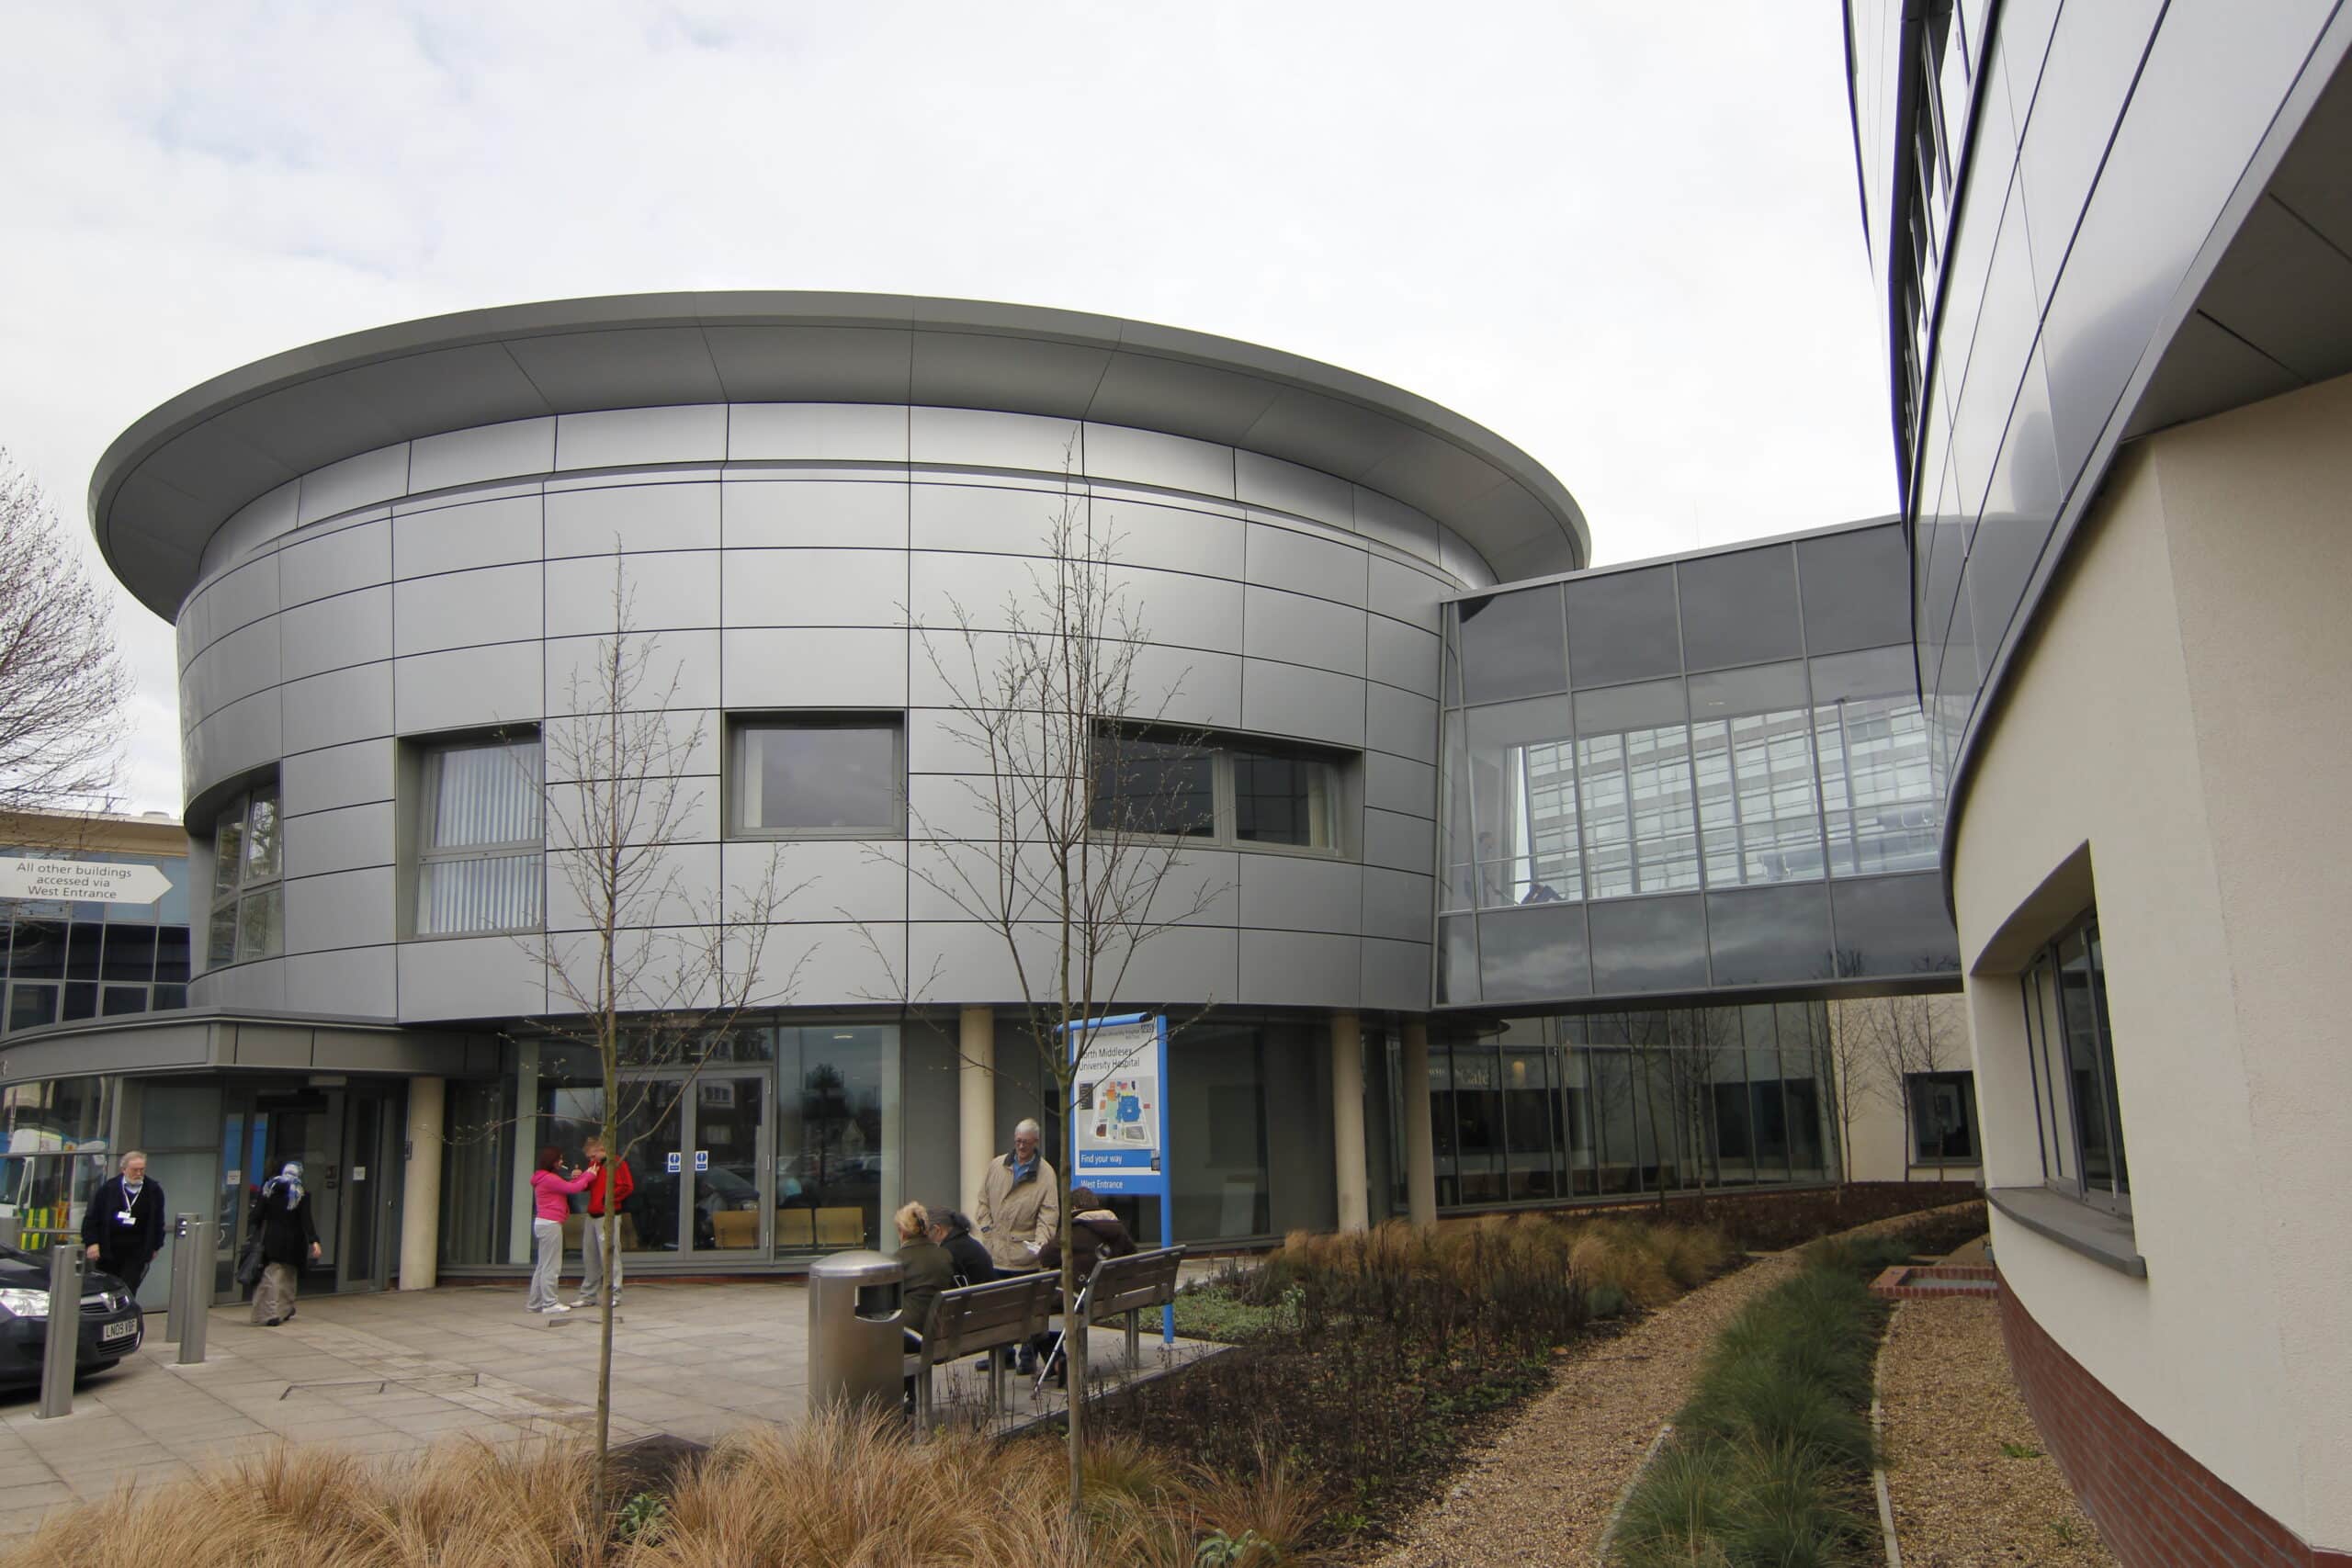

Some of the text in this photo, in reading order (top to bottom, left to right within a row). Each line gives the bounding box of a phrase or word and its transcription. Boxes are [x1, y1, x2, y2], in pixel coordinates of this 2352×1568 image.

[16, 862, 132, 879] All other buildings
[37, 875, 110, 888] accessed via
[28, 886, 118, 899] West Entrance
[1081, 1046, 1132, 1059] orth Middlesex
[1080, 1057, 1139, 1071] University Hospital
[1080, 1154, 1122, 1165] Find your way
[1080, 1179, 1123, 1190] West Entrance
